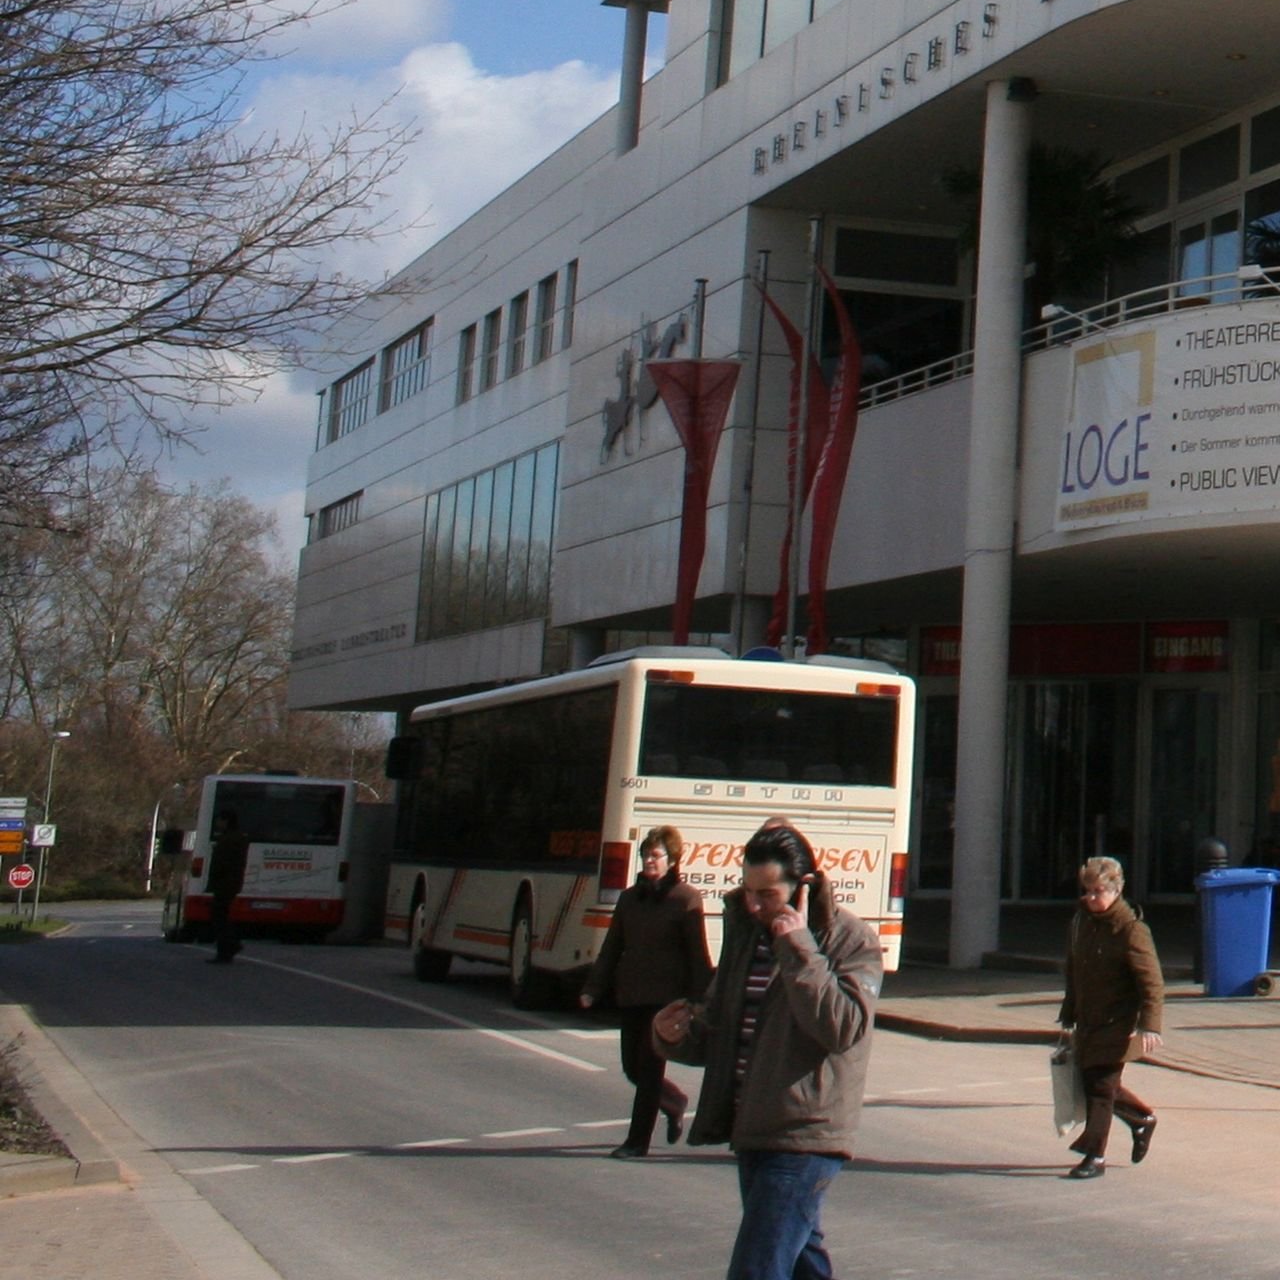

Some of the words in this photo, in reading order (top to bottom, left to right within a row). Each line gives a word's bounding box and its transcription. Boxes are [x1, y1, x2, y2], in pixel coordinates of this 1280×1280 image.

[753, 3, 1000, 175] RHEINISCHES
[1182, 403, 1245, 421] Durchgehend
[1061, 412, 1151, 493] LOGE
[1181, 440, 1197, 453] Der
[1200, 438, 1242, 452] Sommer
[1180, 467, 1237, 492] PUBLIC
[1154, 636, 1224, 658] EINGANG
[620, 777, 648, 790] 5601
[693, 784, 843, 802] SETRA
[12, 870, 33, 881] STOP
